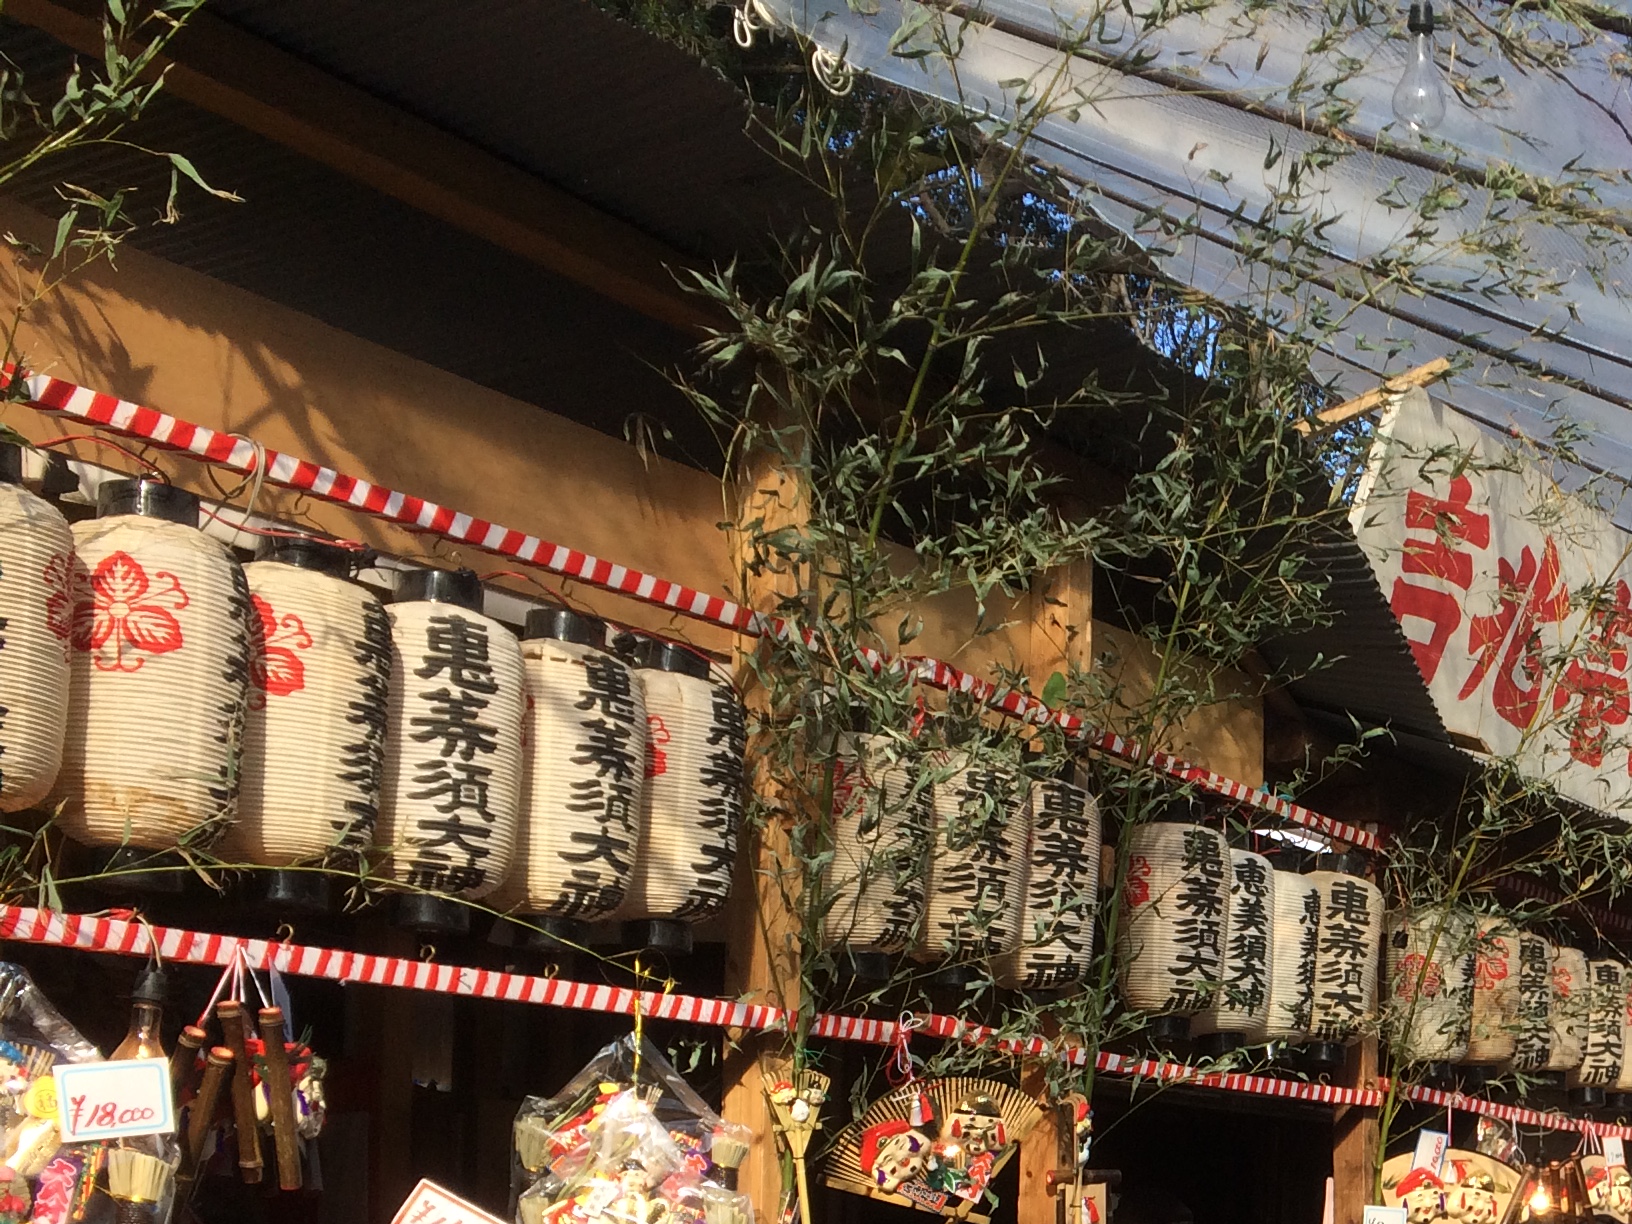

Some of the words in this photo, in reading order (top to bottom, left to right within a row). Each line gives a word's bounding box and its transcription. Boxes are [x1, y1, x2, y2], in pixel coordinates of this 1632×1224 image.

[1220, 858, 1269, 1018] 恵美須大神
[69, 1095, 155, 1136] ¥18,000
